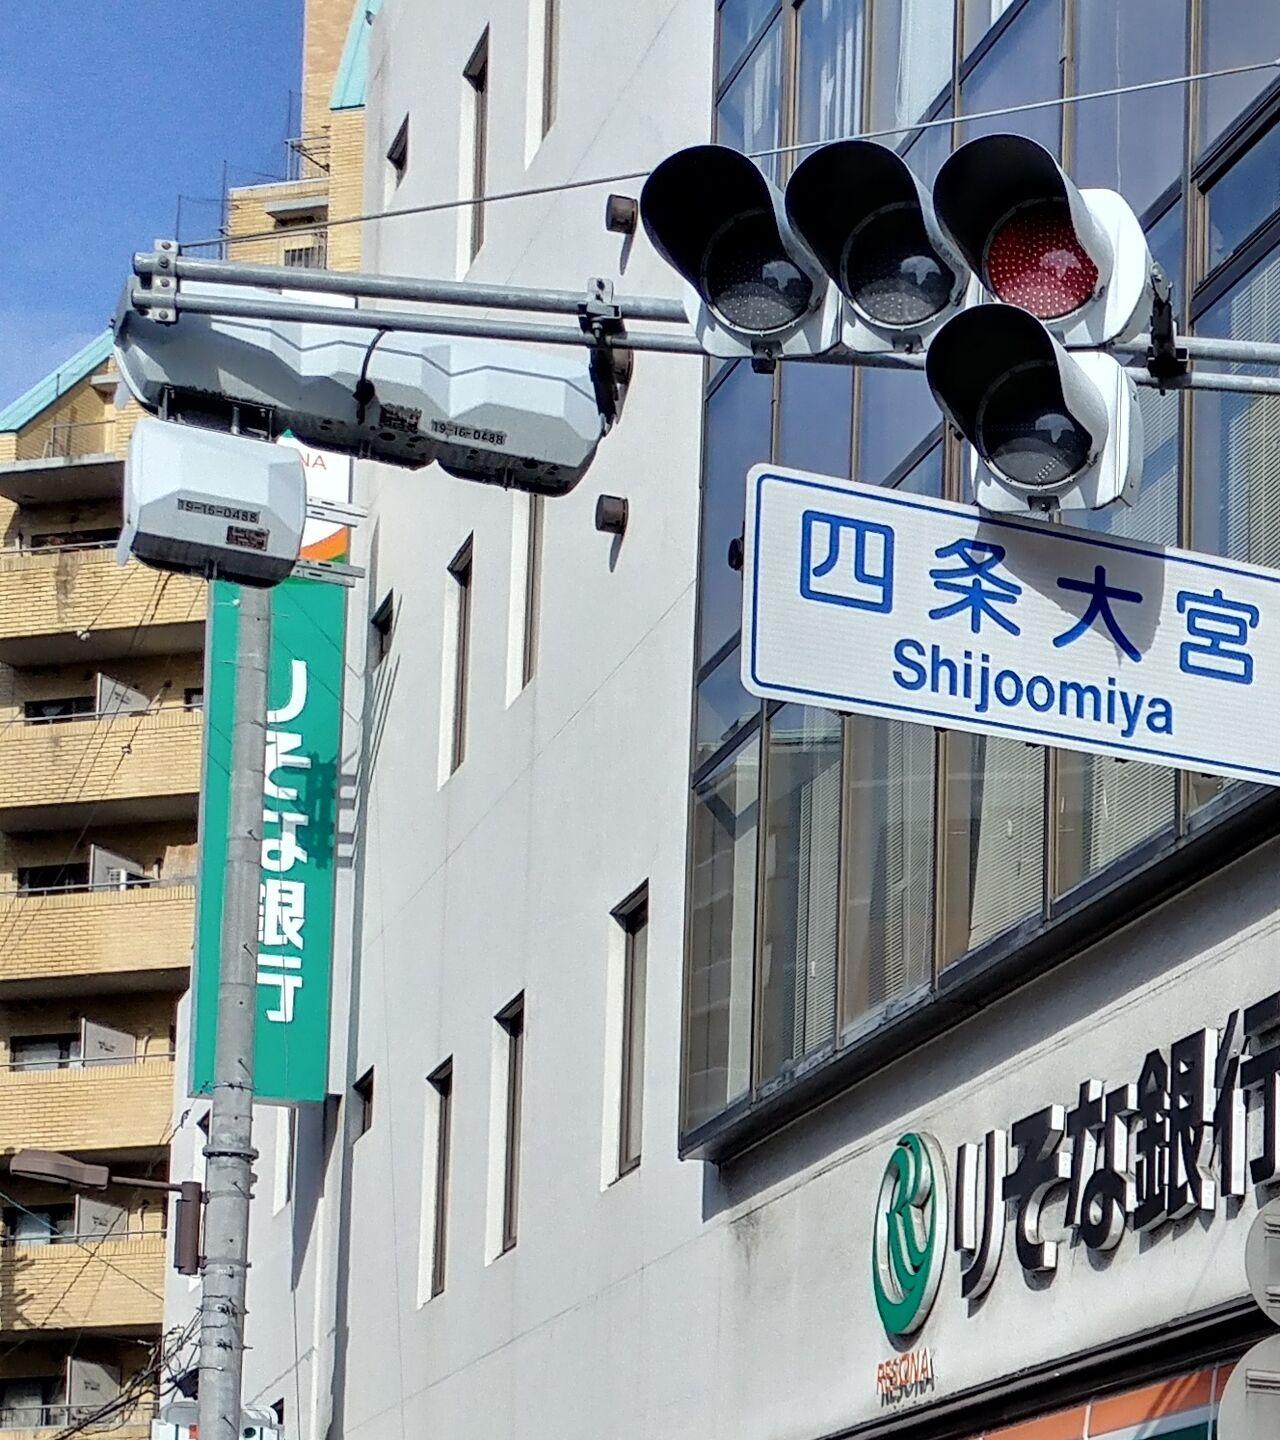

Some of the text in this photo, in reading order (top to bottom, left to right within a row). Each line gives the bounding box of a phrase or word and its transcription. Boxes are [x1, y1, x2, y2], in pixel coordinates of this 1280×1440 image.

[800, 510, 1259, 685] 四条大宮
[893, 638, 1174, 738] Shijoomiya
[876, 1348, 930, 1395] RESONA
